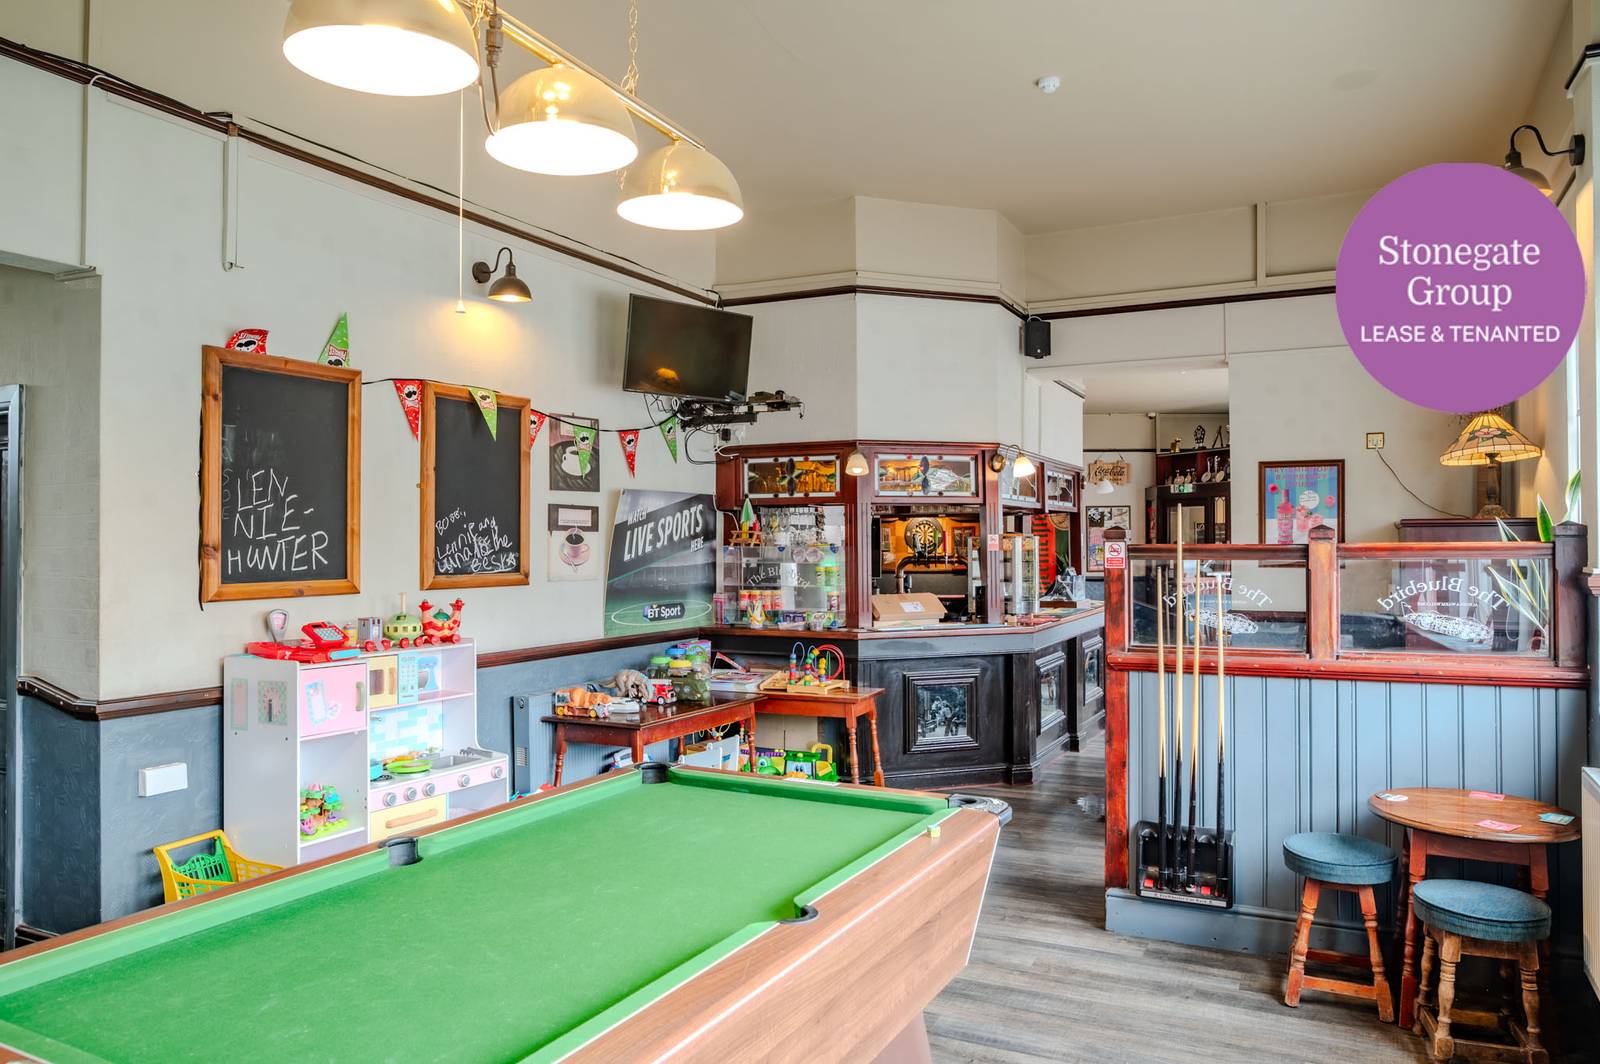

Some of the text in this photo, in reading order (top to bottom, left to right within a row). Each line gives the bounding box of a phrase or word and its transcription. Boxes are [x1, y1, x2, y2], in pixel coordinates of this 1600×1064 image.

[237, 467, 289, 512] LEN
[626, 506, 648, 526] WATCH
[623, 503, 704, 561] LIVE SPORTS
[227, 530, 329, 575] HUNTER
[690, 536, 704, 552] HERE
[746, 570, 767, 587] The
[648, 604, 681, 620] BT Sport
